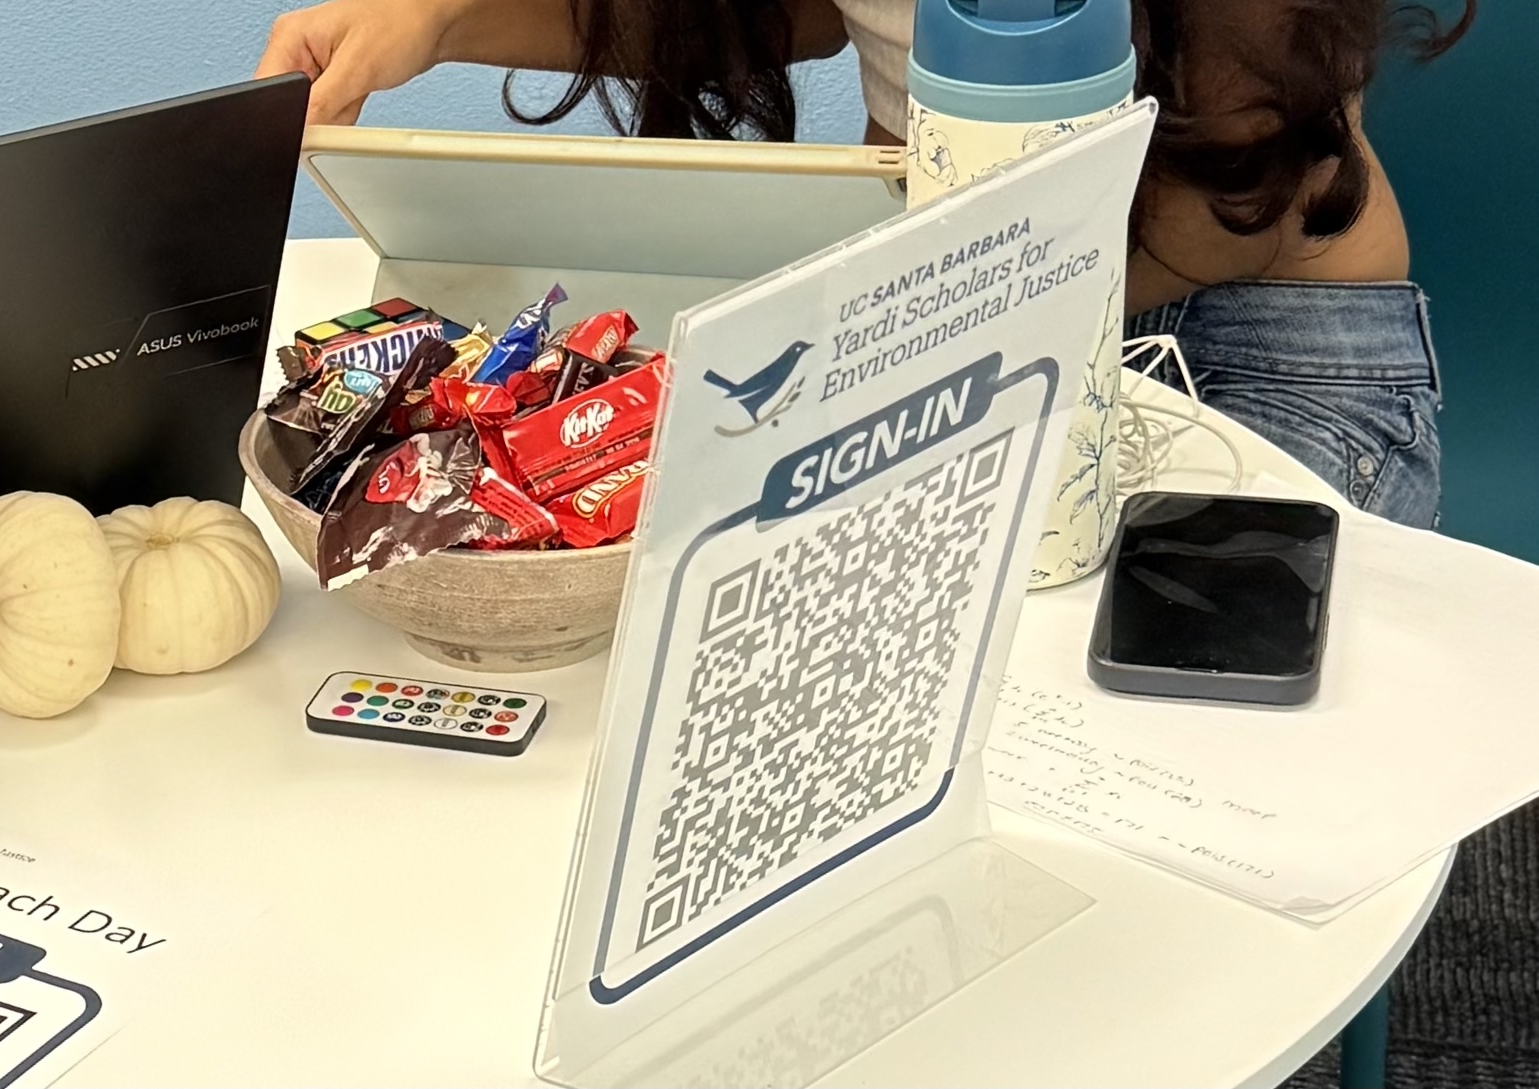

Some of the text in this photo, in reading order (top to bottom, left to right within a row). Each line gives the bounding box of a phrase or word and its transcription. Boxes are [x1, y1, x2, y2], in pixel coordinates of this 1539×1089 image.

[819, 248, 1100, 403] Environmental Justice
[831, 237, 1055, 362] Yardi Scholars for
[838, 216, 1031, 323] UC SANTA BARBARA
[137, 316, 260, 356] ASUS Vivobook
[785, 376, 972, 509] SIGN-IN
[67, 909, 167, 955] Day
